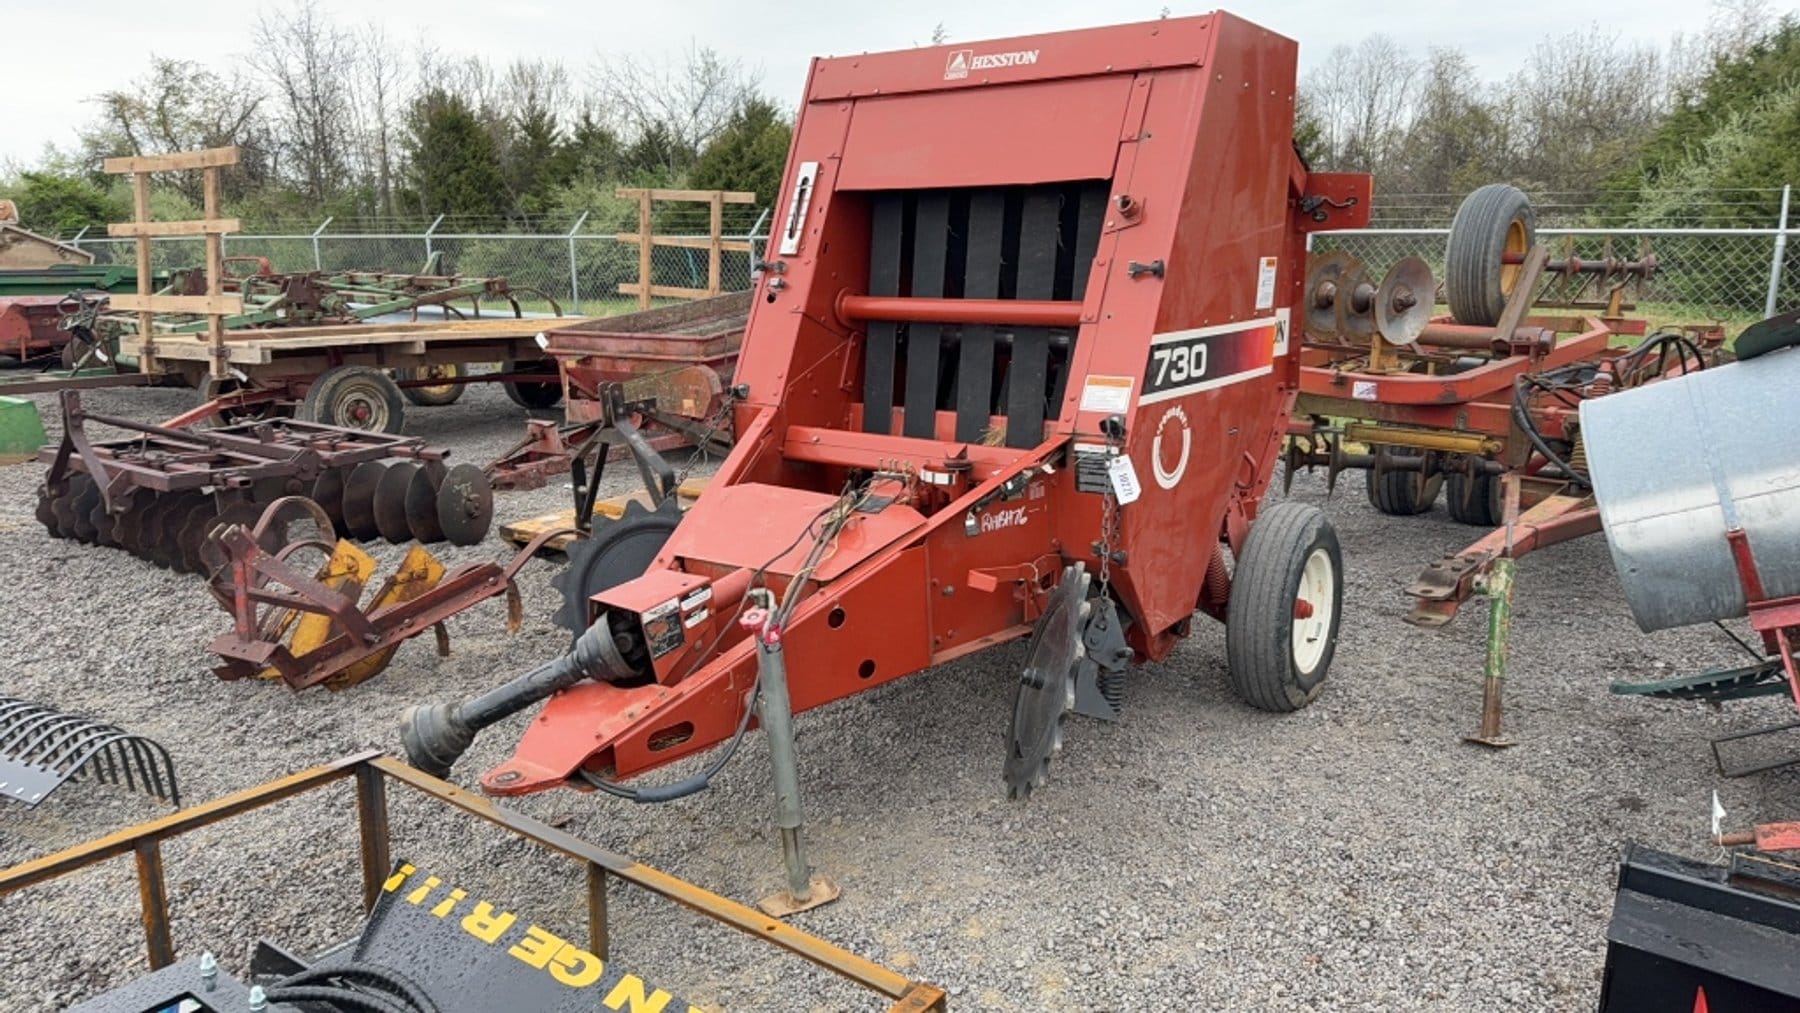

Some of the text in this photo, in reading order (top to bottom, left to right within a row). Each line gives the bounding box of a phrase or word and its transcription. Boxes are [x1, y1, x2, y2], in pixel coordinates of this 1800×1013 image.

[971, 51, 1039, 69] HESSTON
[1153, 343, 1208, 387] 730
[383, 863, 704, 1013] NGER!!!
